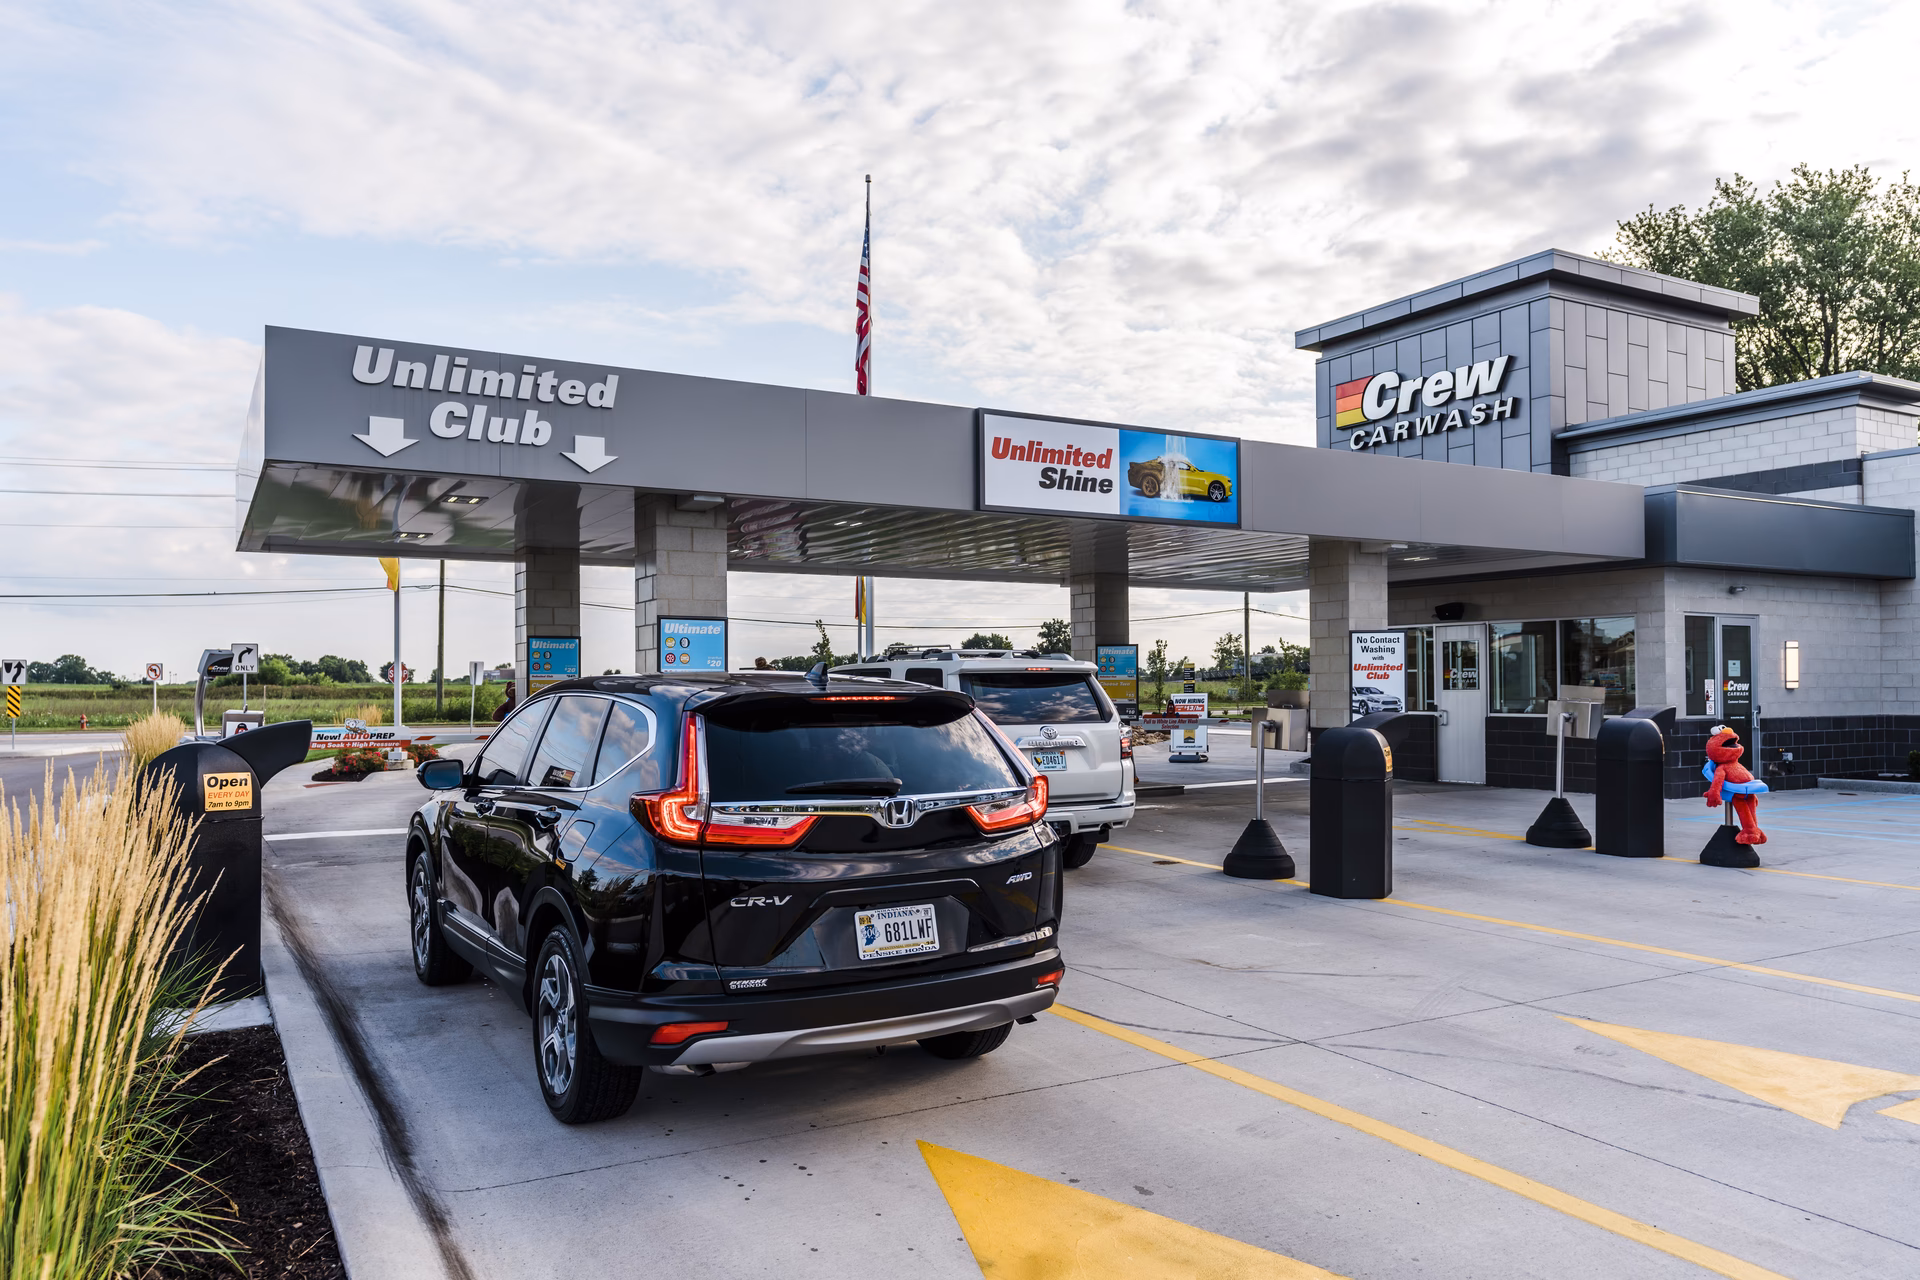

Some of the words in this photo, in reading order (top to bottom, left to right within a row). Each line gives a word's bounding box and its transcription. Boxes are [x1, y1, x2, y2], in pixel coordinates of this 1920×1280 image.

[352, 345, 619, 409] Unlimited
[1362, 355, 1513, 420] Crew
[429, 401, 552, 446] Club
[1350, 396, 1517, 450] CARWASH
[991, 437, 1113, 469] Unlimited
[1039, 467, 1113, 493] Shine
[664, 623, 721, 635] Ultimate
[532, 641, 576, 649] Ultimate
[1357, 636, 1368, 644] No
[1370, 636, 1400, 644] Contact
[1361, 645, 1396, 654] Washing
[1353, 663, 1403, 671] Unlimited
[389, 669, 408, 678] SP
[1366, 672, 1390, 680] Club
[1450, 669, 1477, 679] Crew
[1728, 680, 1749, 690] Crew
[207, 776, 248, 790] Open
[1006, 872, 1032, 884] AWD
[730, 895, 792, 907] CR-V
[877, 910, 913, 919] INDIANA
